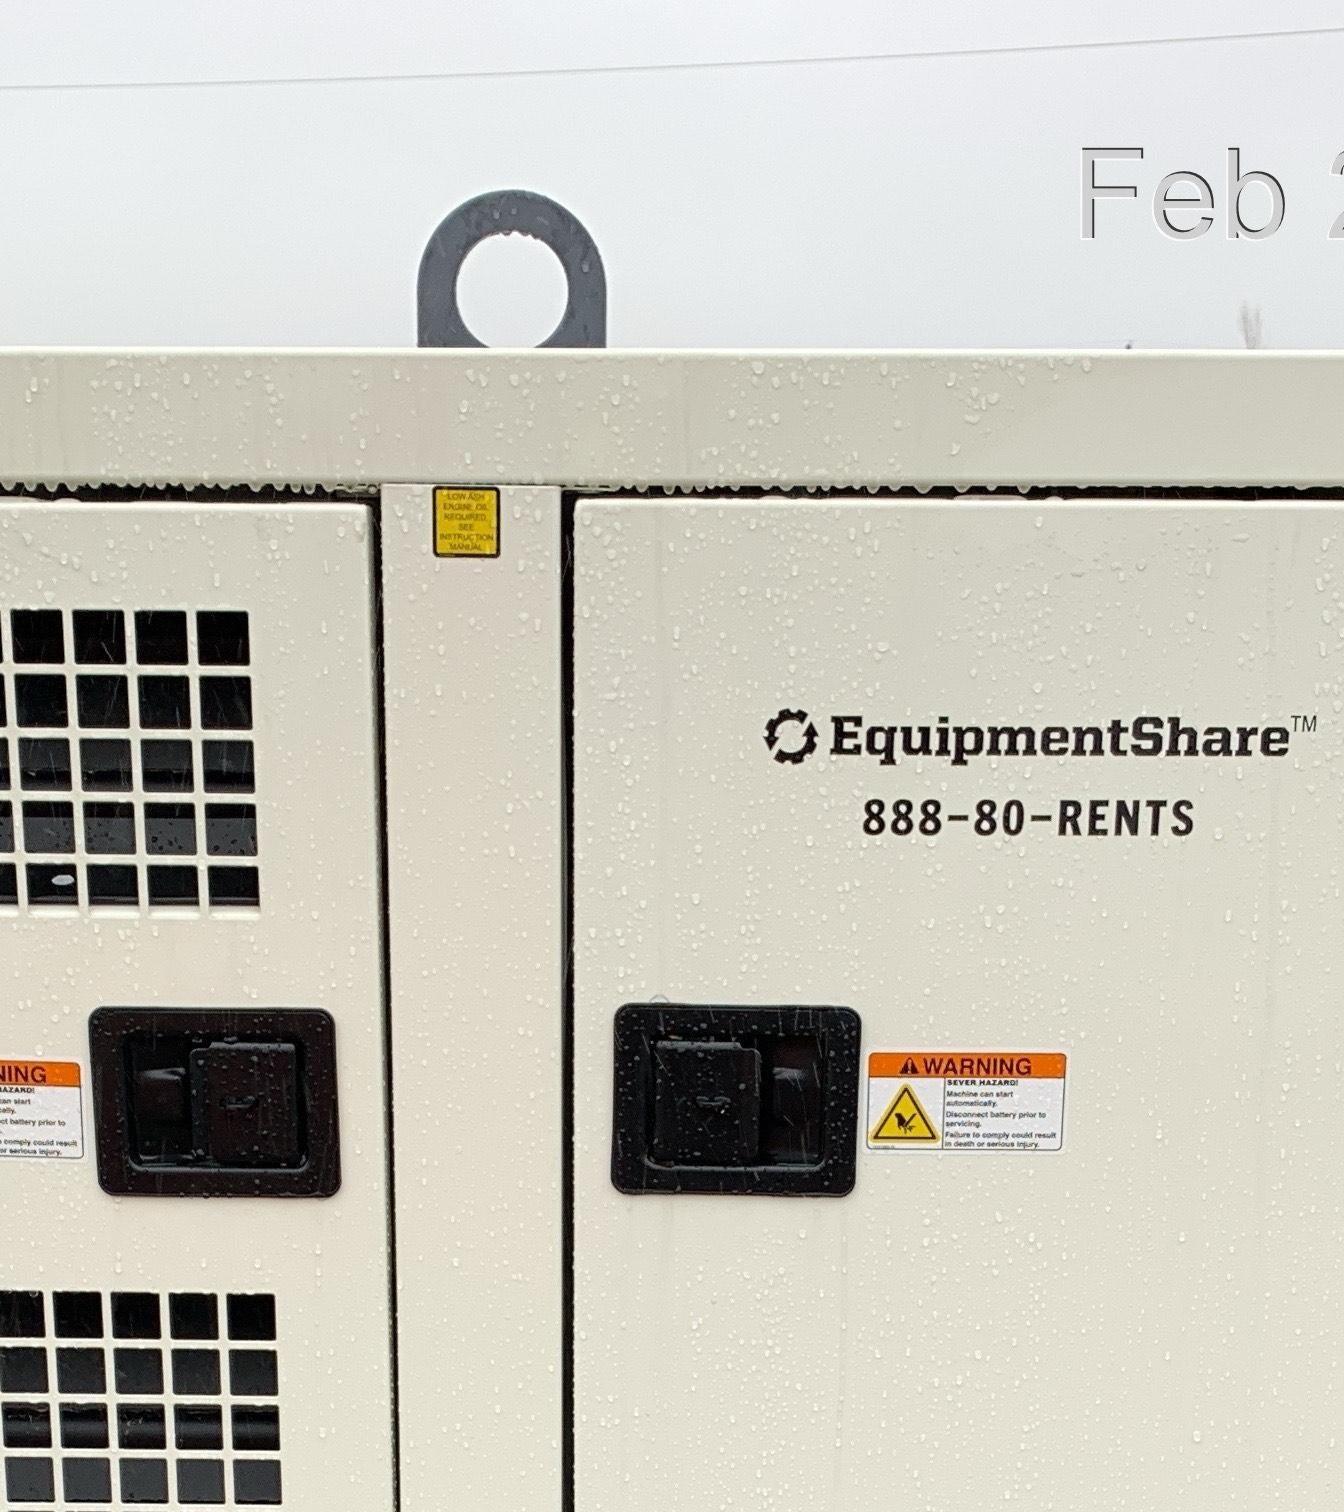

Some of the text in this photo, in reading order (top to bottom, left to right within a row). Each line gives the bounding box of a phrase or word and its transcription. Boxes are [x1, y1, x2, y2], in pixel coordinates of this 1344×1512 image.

[862, 798, 1195, 837] 888-80-RENTS
[924, 1057, 1032, 1076] WARNING
[990, 1111, 1016, 1119] battery
[10, 1118, 35, 1126] battery
